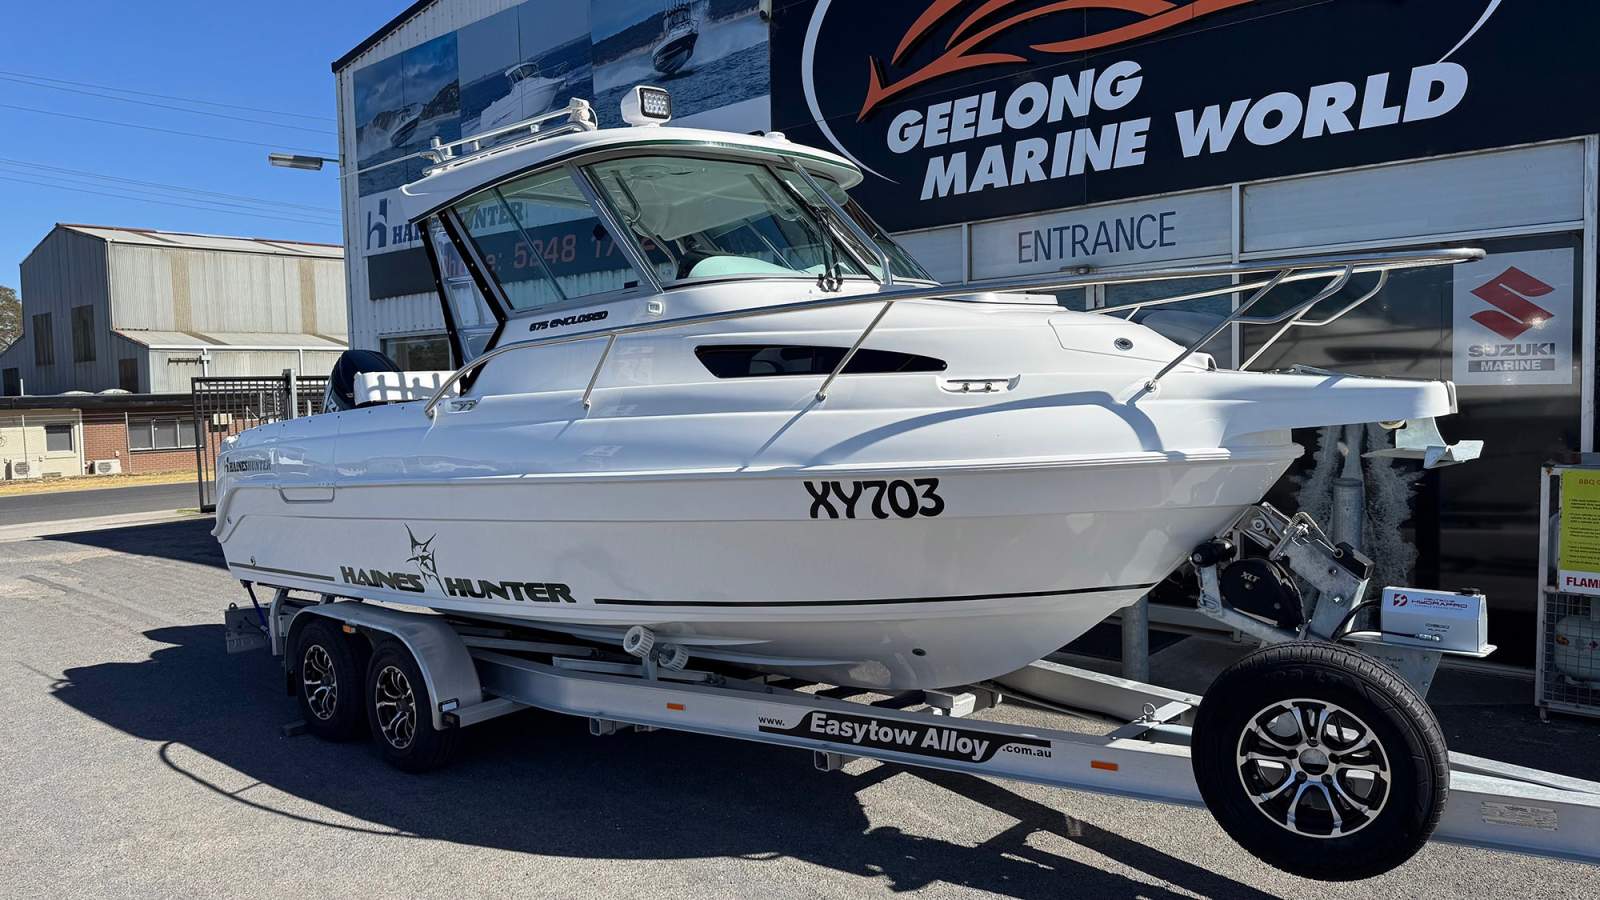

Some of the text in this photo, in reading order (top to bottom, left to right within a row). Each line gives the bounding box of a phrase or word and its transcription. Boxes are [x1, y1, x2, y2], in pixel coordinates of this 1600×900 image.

[887, 60, 1144, 154] GEELONG
[920, 62, 1469, 201] MARINE WORLD
[1018, 211, 1177, 264] ENTRANCE
[1468, 343, 1556, 358] SUZUKI
[1480, 360, 1542, 371] MARINE
[803, 478, 945, 519] XY703
[340, 566, 577, 604] HAINES HUNTER
[1566, 576, 1600, 589] FLAM
[758, 711, 1052, 761] www. Easytow Alloy .com.au
